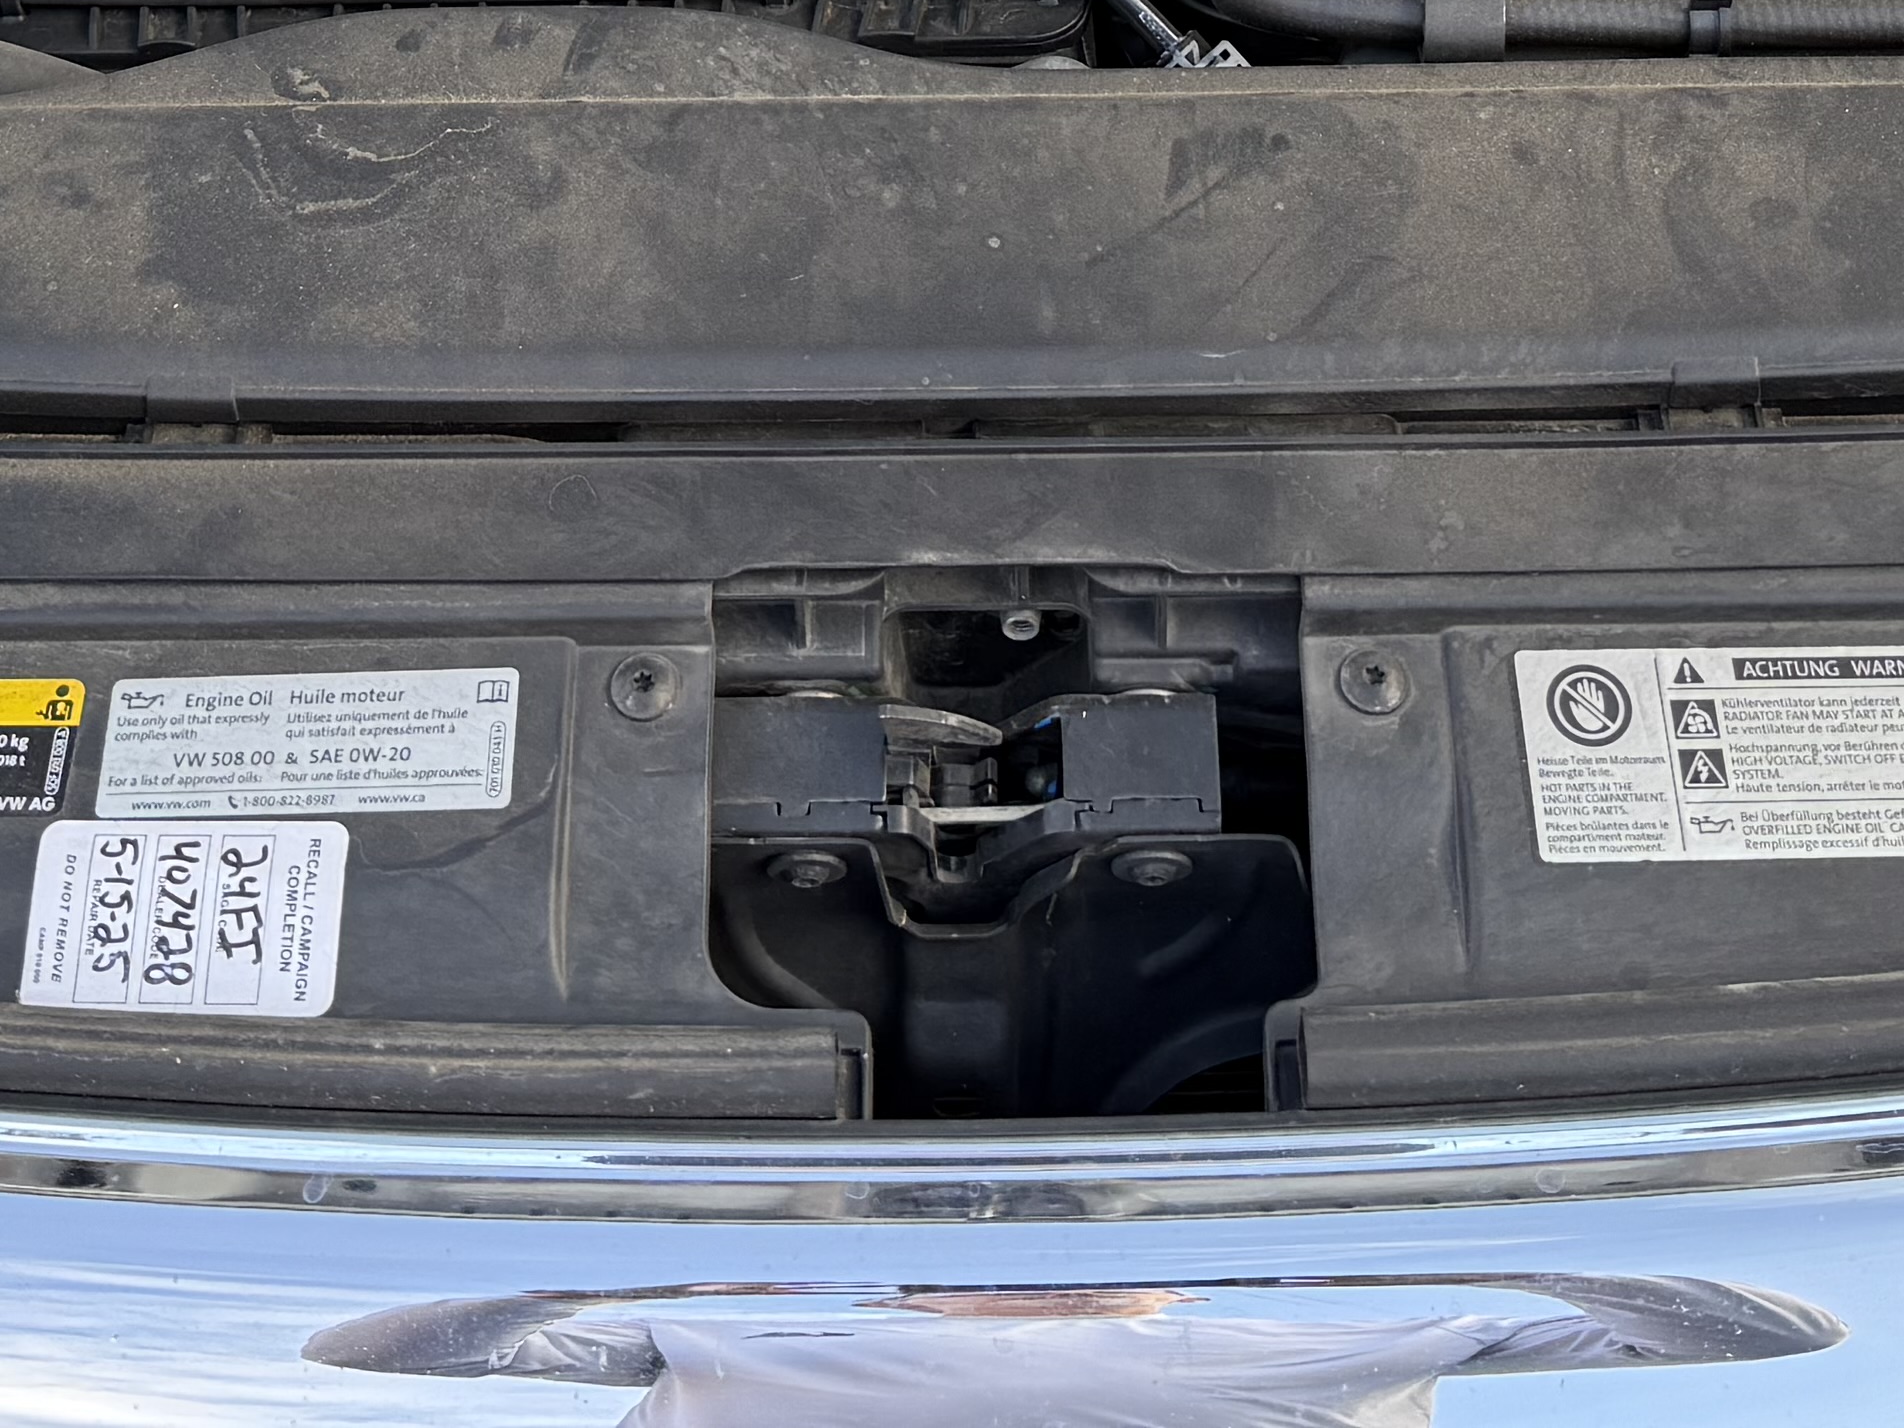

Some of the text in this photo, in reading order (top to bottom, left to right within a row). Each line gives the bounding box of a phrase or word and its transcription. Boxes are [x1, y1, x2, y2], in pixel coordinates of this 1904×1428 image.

[1742, 660, 1840, 678] ACHTUNG
[185, 690, 273, 711] Engine Oil
[290, 689, 405, 706] Huile moteur
[117, 712, 270, 730] Use only oil that expressly
[286, 707, 469, 725] Utilisez uniquement de l'huile
[1723, 711, 1783, 721] RADIATOR
[1786, 710, 1809, 720] FAN
[1812, 710, 1838, 720] MAY
[1842, 709, 1877, 720] START
[1881, 709, 1894, 719] AT
[114, 728, 197, 744] complies with
[285, 722, 456, 740] qui satisfait expressément à
[10, 734, 30, 752] kg
[20, 754, 26, 766] t
[173, 747, 412, 767] VW 508 00 & SAE 0W-20
[1731, 755, 1764, 766] HIGH
[1766, 754, 1823, 767] VOLTAGE,
[1825, 753, 1872, 765] SWITCH
[1874, 752, 1897, 765] OFF
[108, 775, 128, 788] For
[130, 777, 138, 787] a
[140, 774, 160, 786] list
[162, 773, 175, 786] of
[177, 773, 235, 787] approved
[280, 771, 308, 784] Pour
[310, 772, 333, 782] une
[336, 770, 360, 781] liste
[362, 769, 408, 780] d'huiles
[1541, 782, 1633, 793] HOT PARTS IN THE
[28, 796, 56, 811] AG
[131, 797, 211, 811] www.vw.com
[358, 793, 426, 805] www.vw.ca
[1542, 793, 1668, 804] ENGINE COMPARTMENT.
[1742, 823, 1813, 835] OVERFILLED
[1815, 822, 1862, 834] ENGINE
[1865, 822, 1884, 834] OIL
[302, 838, 322, 902] RECALL
[51, 854, 77, 983] DO NOT REMOVE
[92, 837, 139, 984] 5-15-25
[143, 840, 202, 986] 407428
[279, 865, 301, 973] COMPLETION
[294, 913, 314, 1002] CAMPAIGN
